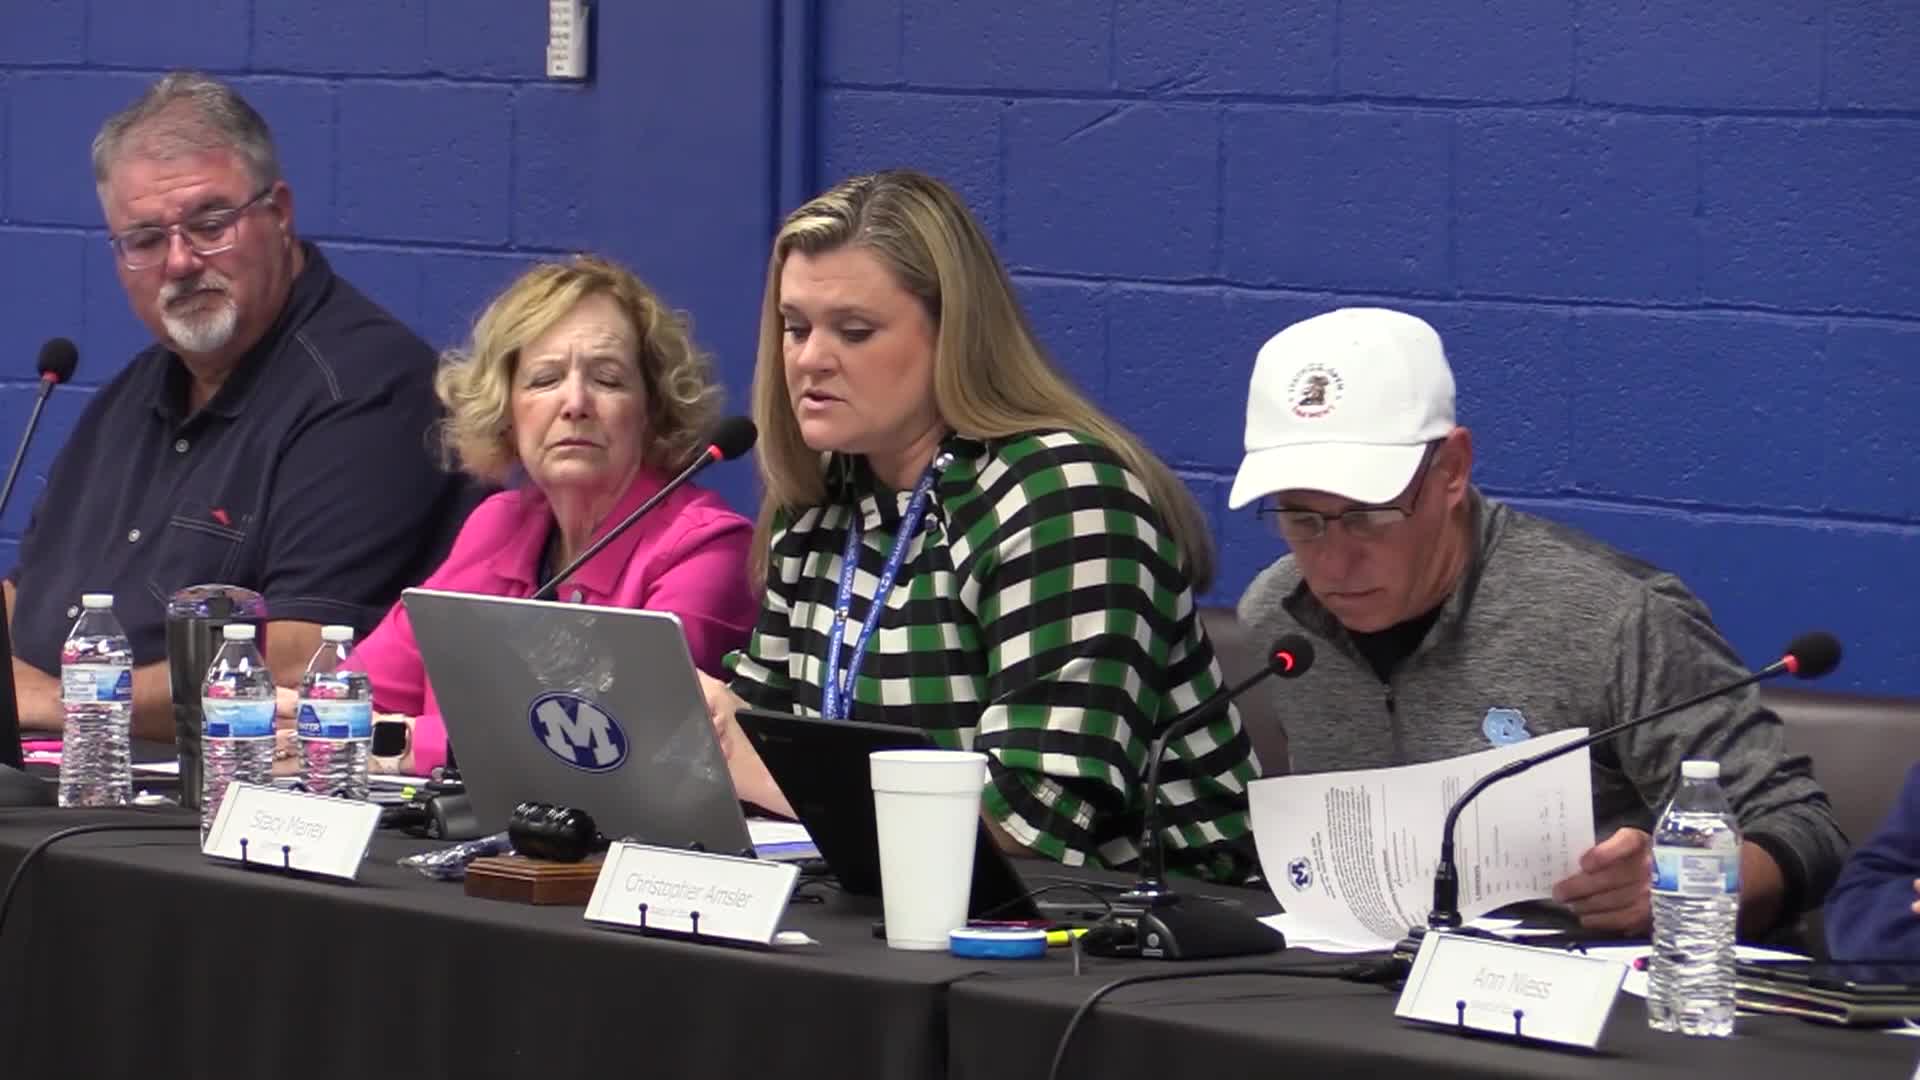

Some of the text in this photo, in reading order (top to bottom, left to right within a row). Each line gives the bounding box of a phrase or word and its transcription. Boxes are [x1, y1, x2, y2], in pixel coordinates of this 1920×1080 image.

[536, 698, 621, 766] M
[624, 871, 755, 909] Christopher Amsler
[1472, 967, 1506, 988] Ann
